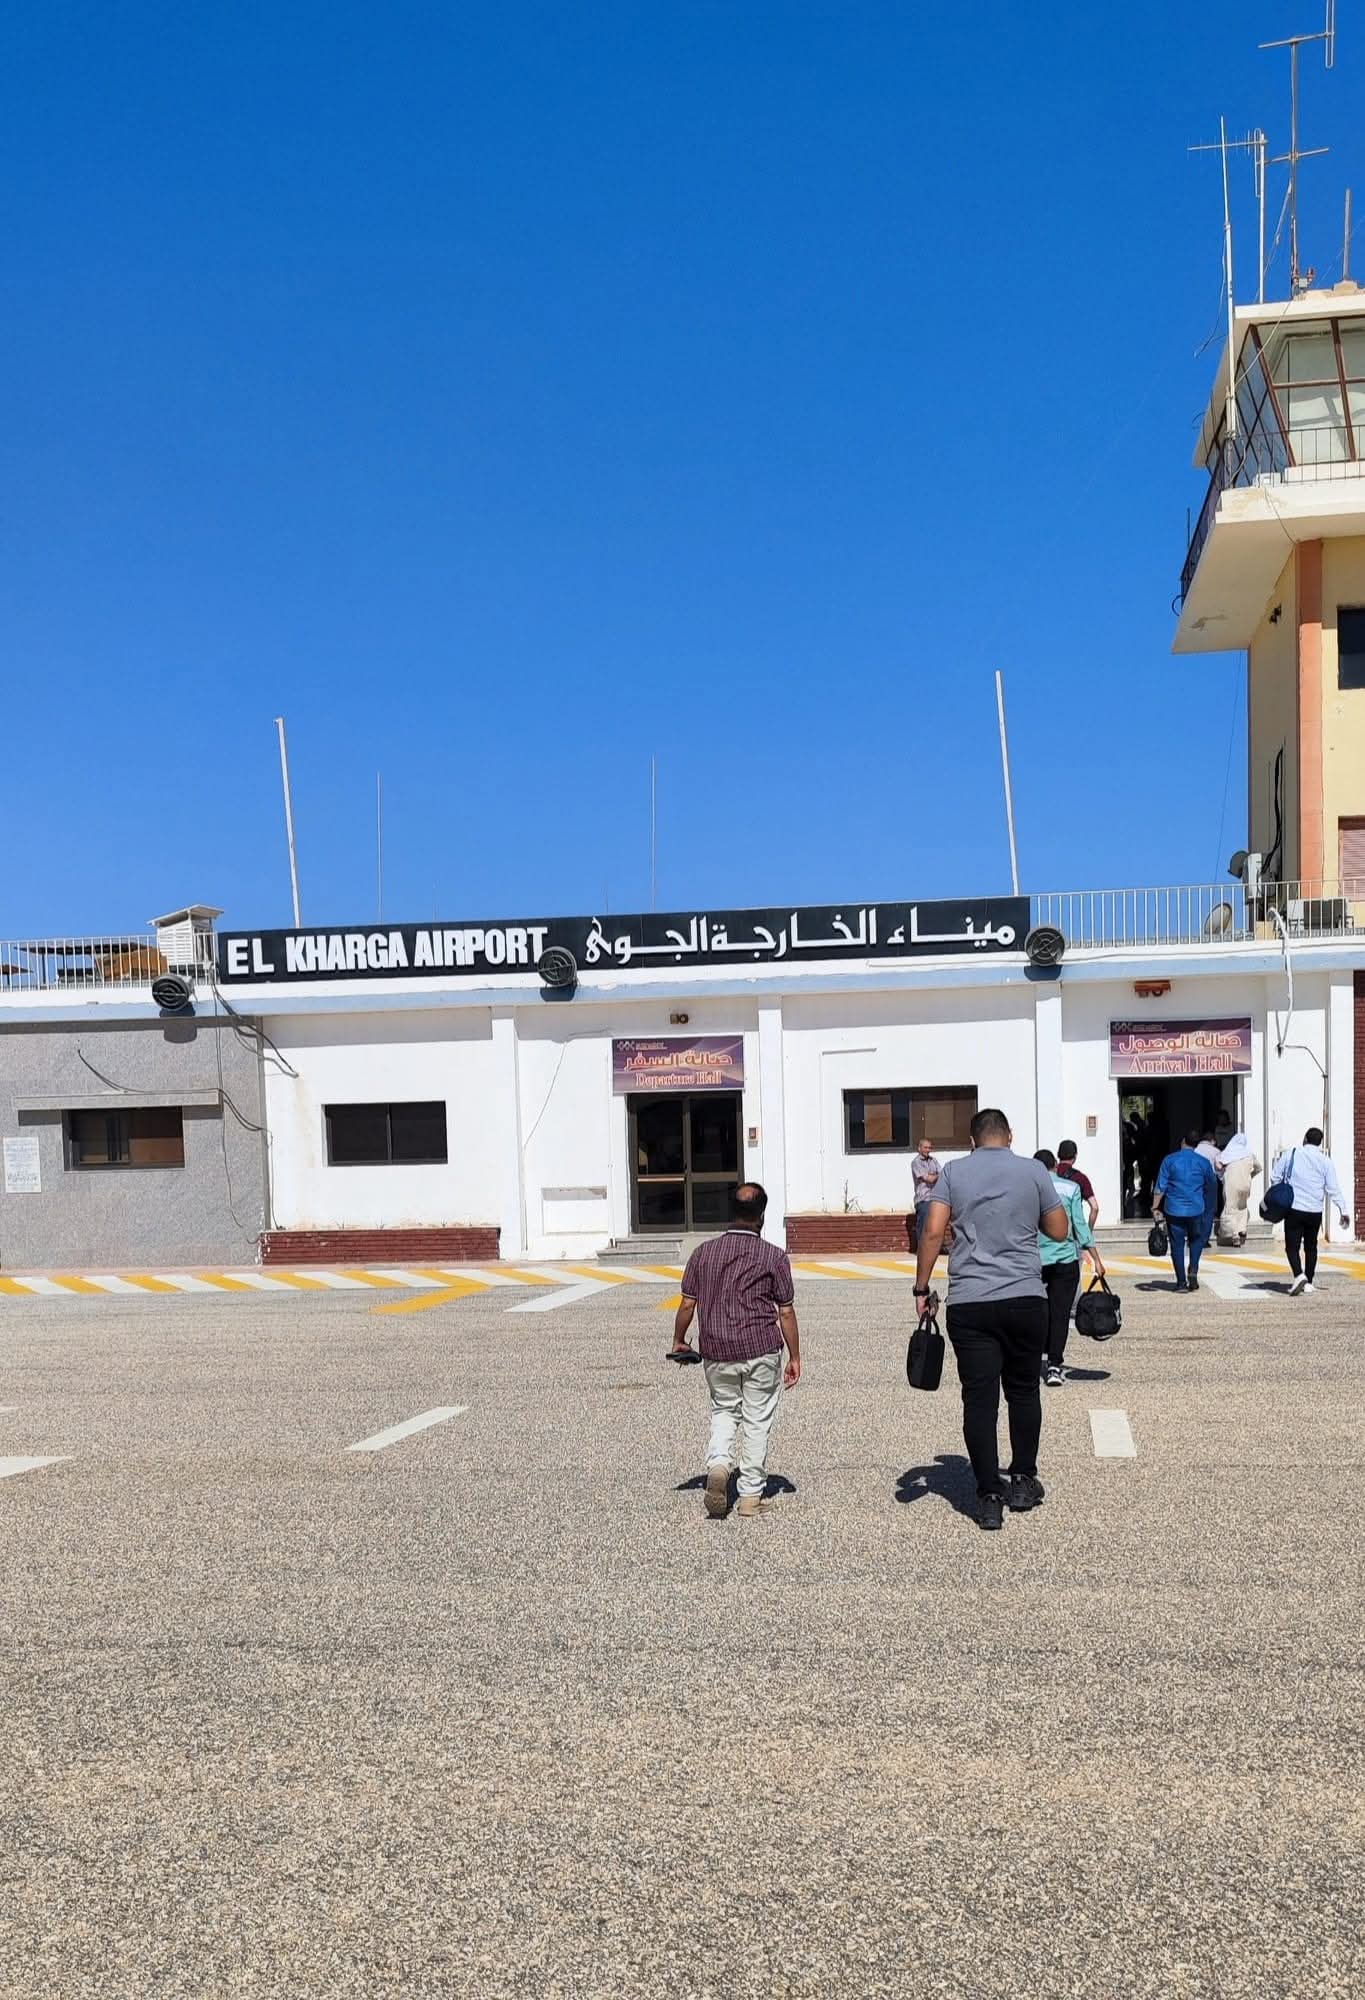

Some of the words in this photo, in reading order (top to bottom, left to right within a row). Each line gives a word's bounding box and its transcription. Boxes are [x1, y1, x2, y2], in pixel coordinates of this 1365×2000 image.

[711, 907, 877, 959] الخارجة
[887, 906, 1015, 948] ميناء
[227, 938, 274, 975] EL
[285, 931, 408, 973] KHARGA
[413, 926, 548, 967] AIRPORT
[1119, 1033, 1190, 1055] الوصول
[1195, 1031, 1242, 1048] صالة
[624, 1052, 678, 1072] السفر
[685, 1050, 733, 1066] صالة
[1129, 1054, 1191, 1073] Arrival
[1195, 1053, 1233, 1072] Hall
[635, 1072, 695, 1088] Departure
[696, 1070, 723, 1084] Hall
